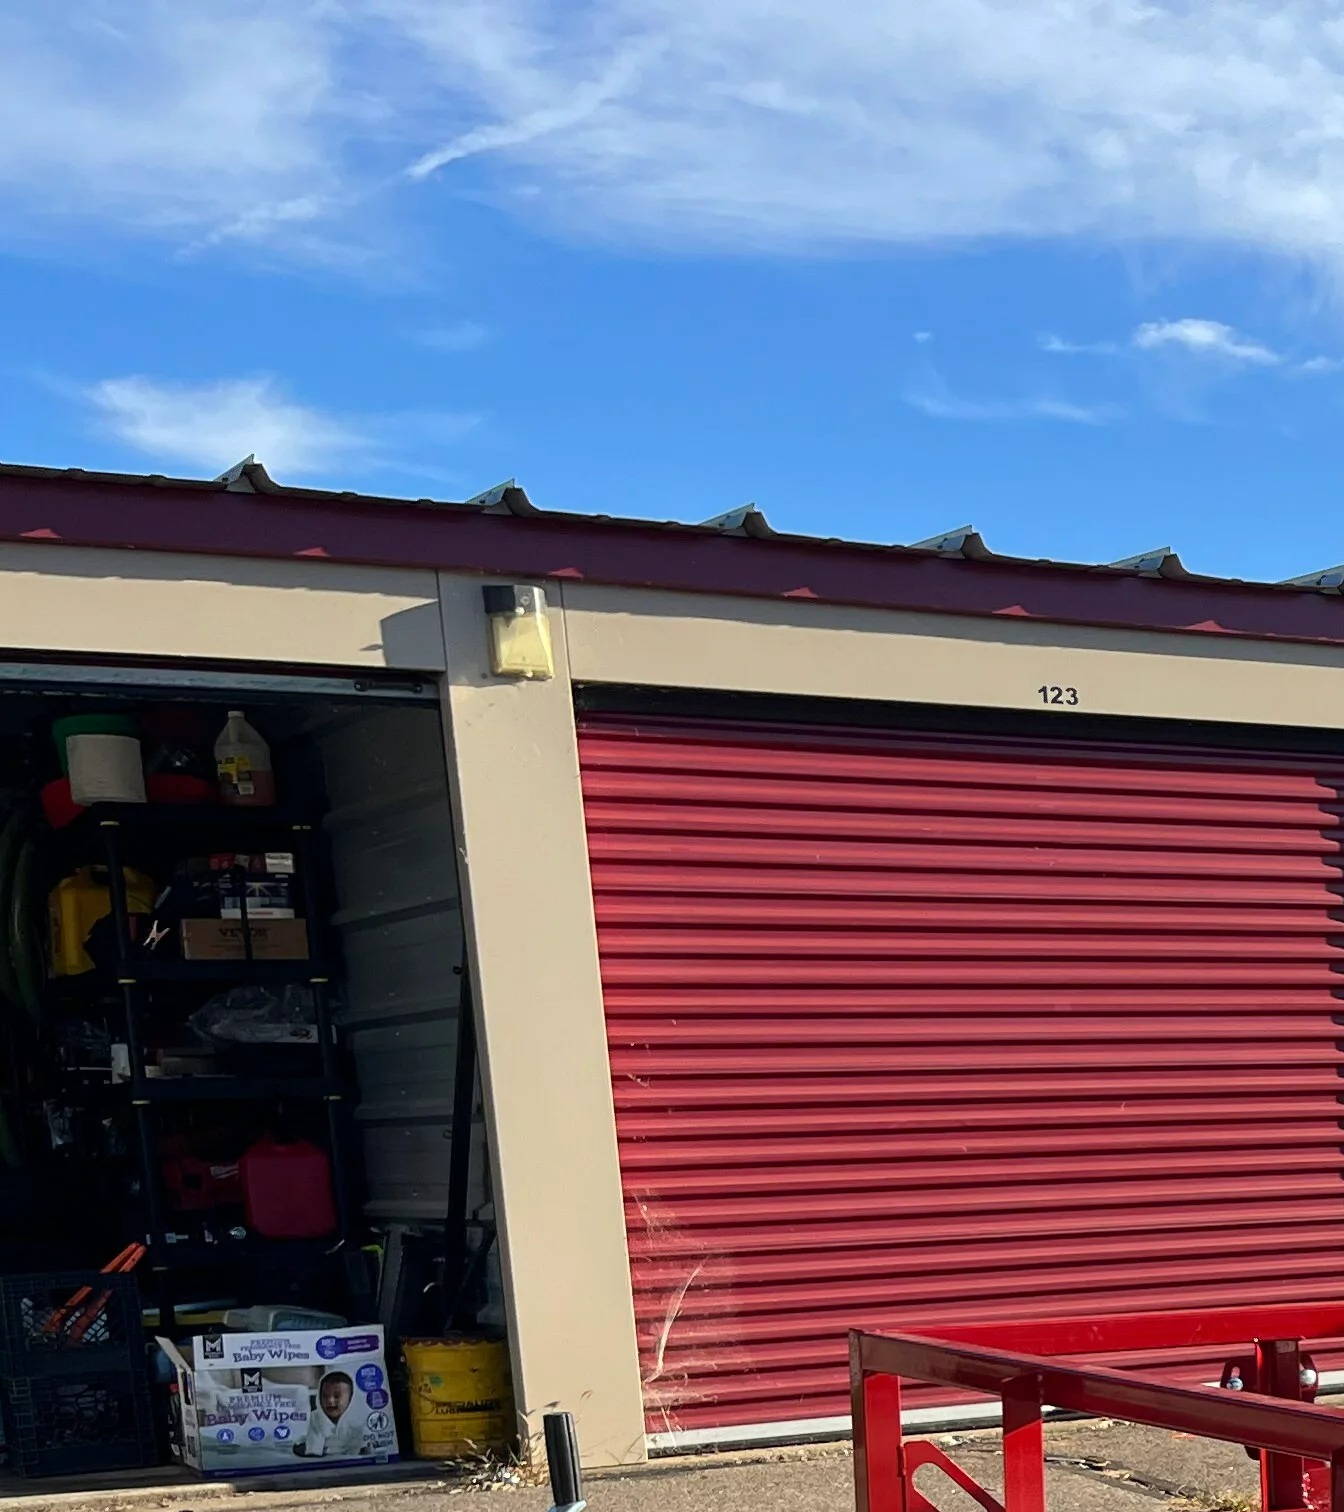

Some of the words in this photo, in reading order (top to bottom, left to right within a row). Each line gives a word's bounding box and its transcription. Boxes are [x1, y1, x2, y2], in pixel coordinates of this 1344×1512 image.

[1038, 685, 1079, 706] 123
[233, 1349, 265, 1363] Baby
[268, 1348, 310, 1361] Wipes
[205, 1411, 249, 1426] Baby
[252, 1408, 307, 1424] Wipes
